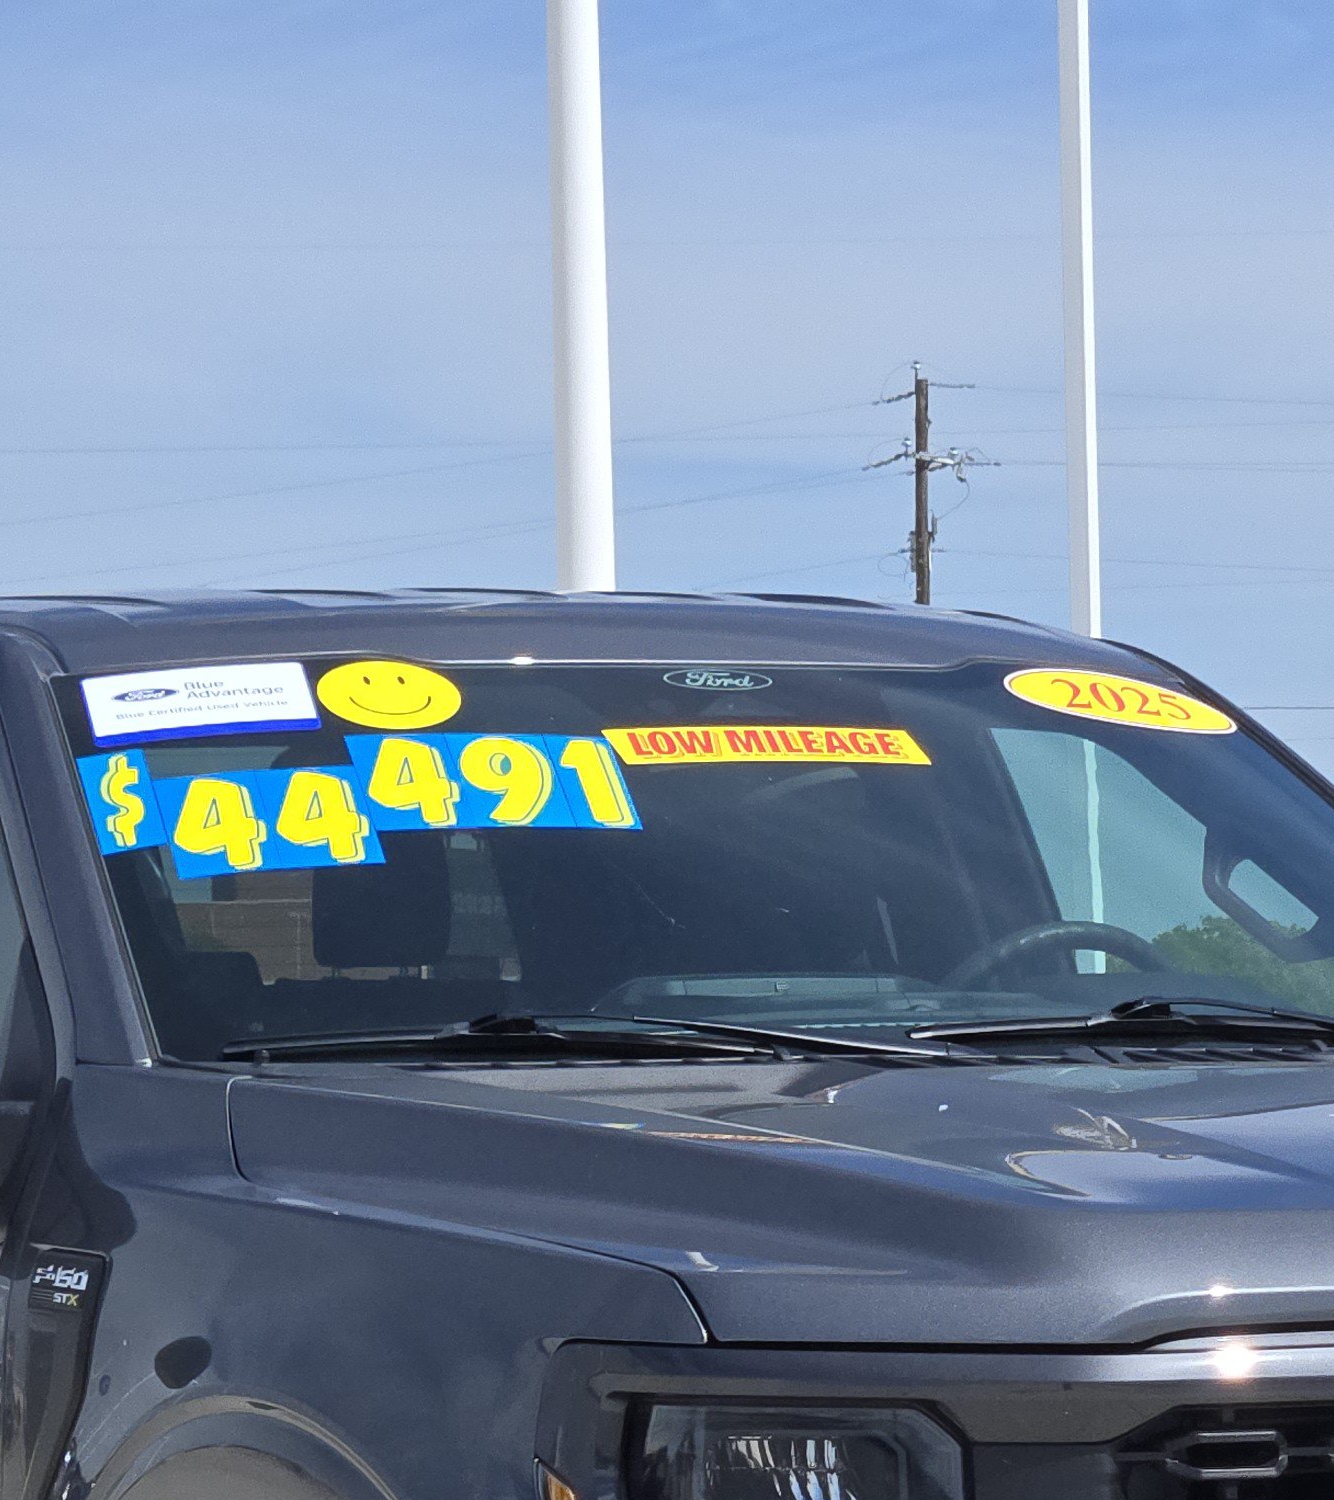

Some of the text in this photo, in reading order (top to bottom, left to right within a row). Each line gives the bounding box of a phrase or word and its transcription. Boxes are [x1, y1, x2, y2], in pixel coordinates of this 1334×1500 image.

[184, 681, 224, 691] Blue
[685, 670, 754, 688] Ford
[186, 686, 284, 700] Advantage
[1050, 678, 1191, 721] 2025
[115, 700, 288, 720] Blue Certified Used Vehicle
[626, 729, 909, 759] LOW MILEAGE
[52, 1292, 80, 1307] STX
